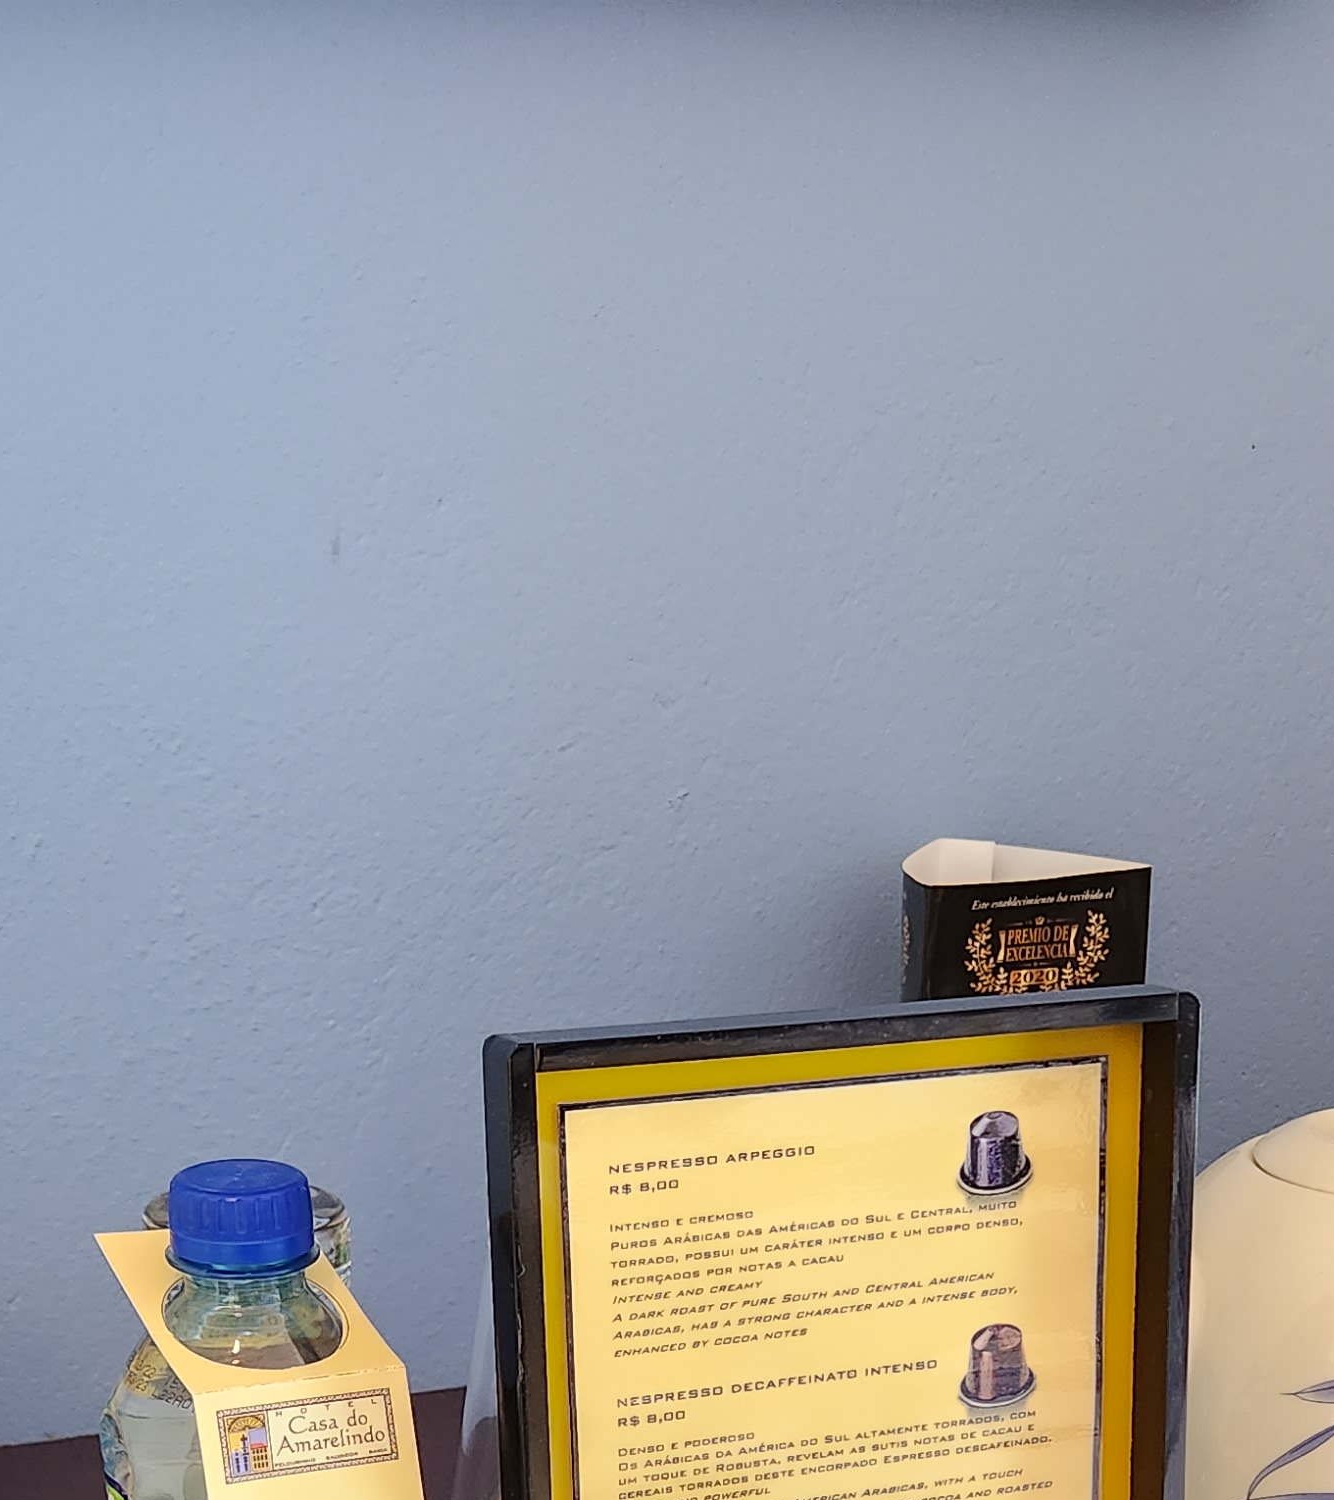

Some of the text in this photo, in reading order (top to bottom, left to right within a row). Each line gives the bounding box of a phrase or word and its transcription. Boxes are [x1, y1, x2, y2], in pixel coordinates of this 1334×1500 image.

[1007, 925, 1069, 946] PREMIO DE
[1005, 942, 1069, 962] EXCELENCIA
[1012, 968, 1057, 985] 2020
[608, 1145, 814, 1174] NESPRESSO ARPEGGIO
[609, 1179, 678, 1195] R$ 8,00
[609, 1210, 753, 1232] INTENSO E CREMOSO
[612, 1280, 762, 1304] INTENSE AND CREAMY
[616, 1359, 937, 1408] NESPRESSO DECAFFEINATO INTENSO
[288, 1408, 368, 1434] Casa do
[276, 1424, 385, 1456] Amarelindo
[617, 1431, 754, 1457] DENSO E PODEROSO
